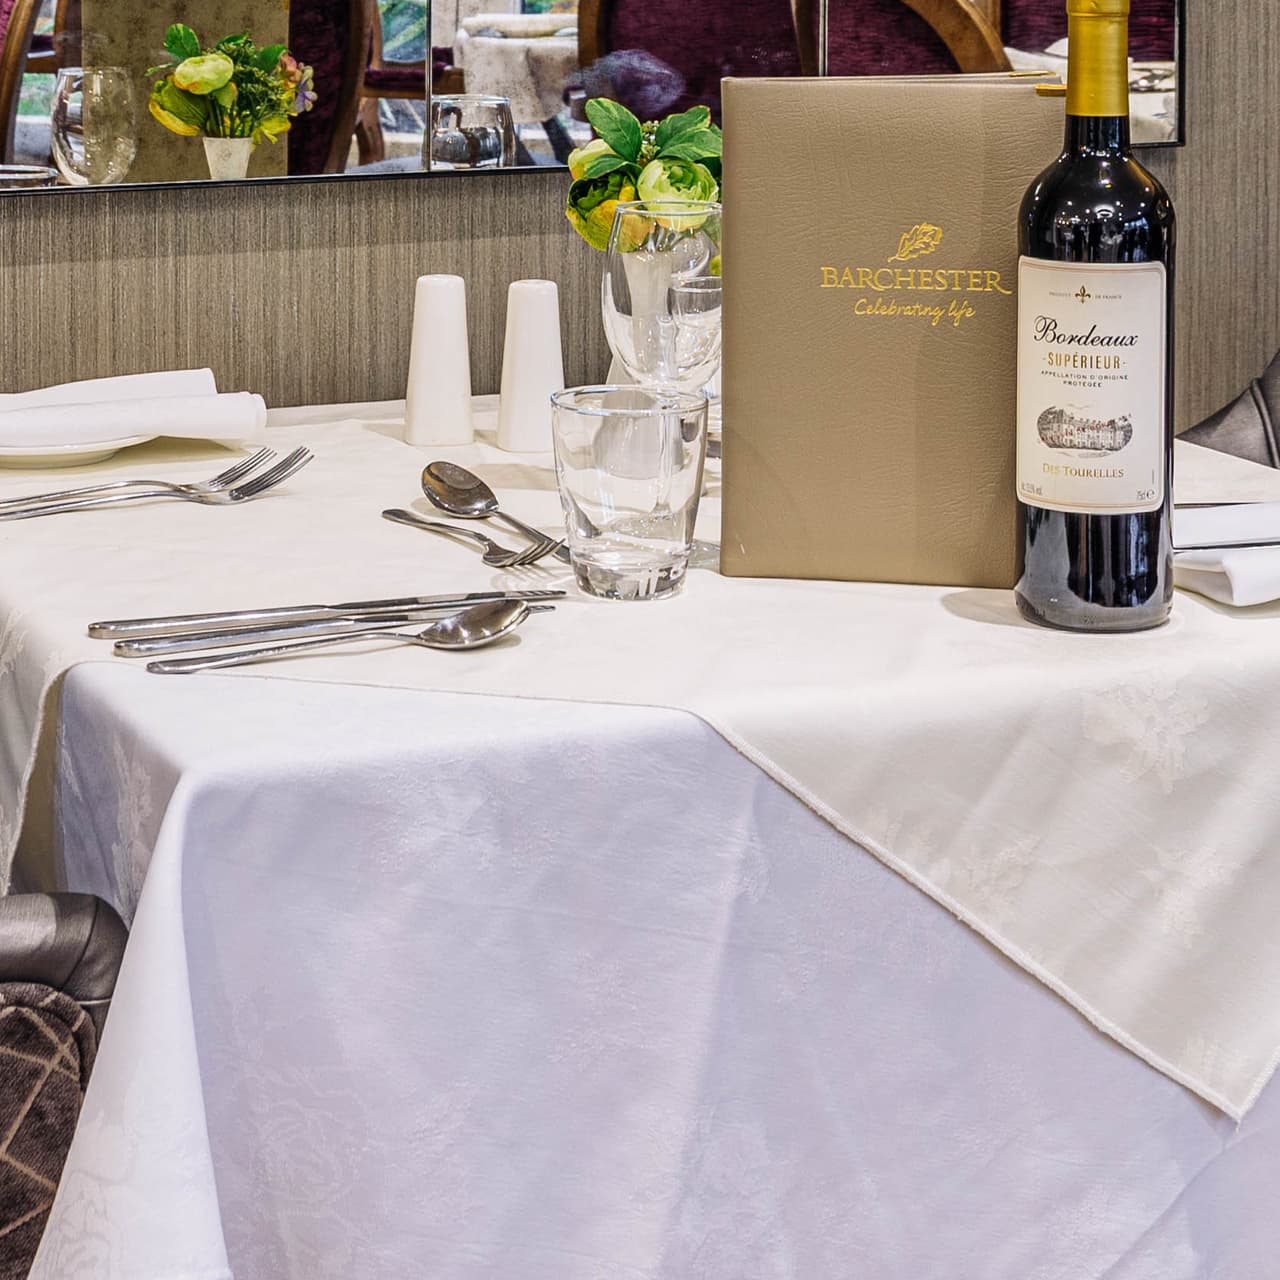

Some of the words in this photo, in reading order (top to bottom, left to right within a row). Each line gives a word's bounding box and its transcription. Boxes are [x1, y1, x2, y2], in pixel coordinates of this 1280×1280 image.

[820, 266, 1013, 294] BARCHESTER
[854, 297, 946, 326] Celebrating
[948, 299, 976, 326] life
[1034, 316, 1138, 347] Bordeaux
[1047, 351, 1121, 369] SUPÉRIEUR
[1040, 370, 1087, 379] APPELLATION
[1063, 466, 1124, 478] TOURELLES
